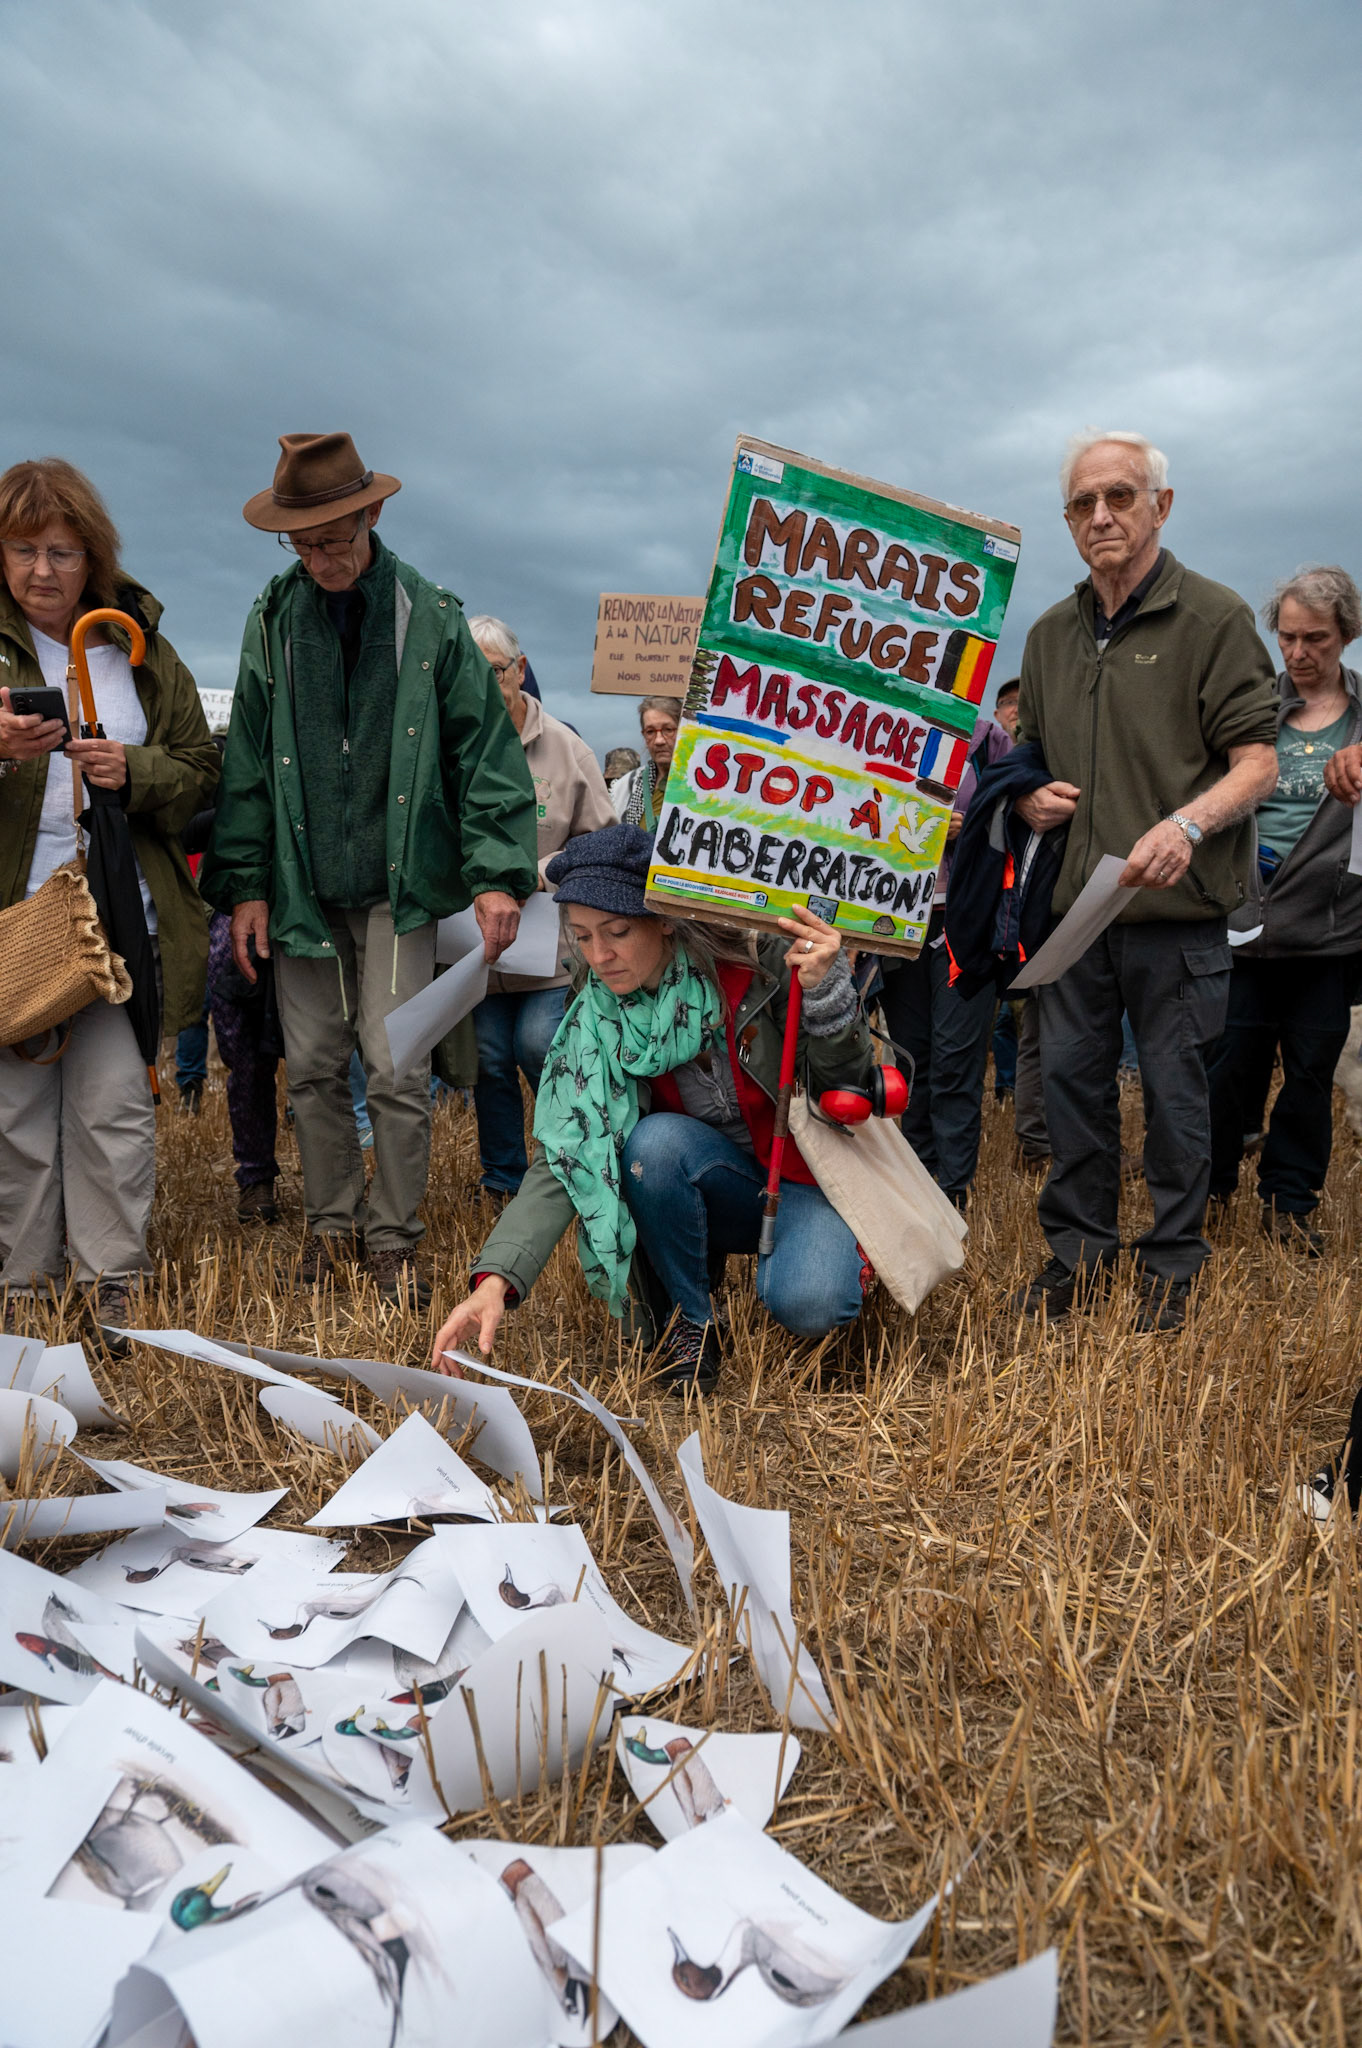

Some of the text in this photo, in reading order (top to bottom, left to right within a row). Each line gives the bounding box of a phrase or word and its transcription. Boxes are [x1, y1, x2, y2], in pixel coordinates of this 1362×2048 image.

[744, 498, 980, 617] MARAIS
[604, 599, 702, 623] RENDONS LA NATUR
[617, 628, 629, 639] LA
[734, 574, 940, 684] REFUGE
[609, 653, 625, 661] ELLE
[679, 654, 692, 663] BIE
[617, 671, 685, 684] NOUS SAUVER
[710, 654, 927, 768] MASSACRE
[694, 743, 883, 840] STOP À
